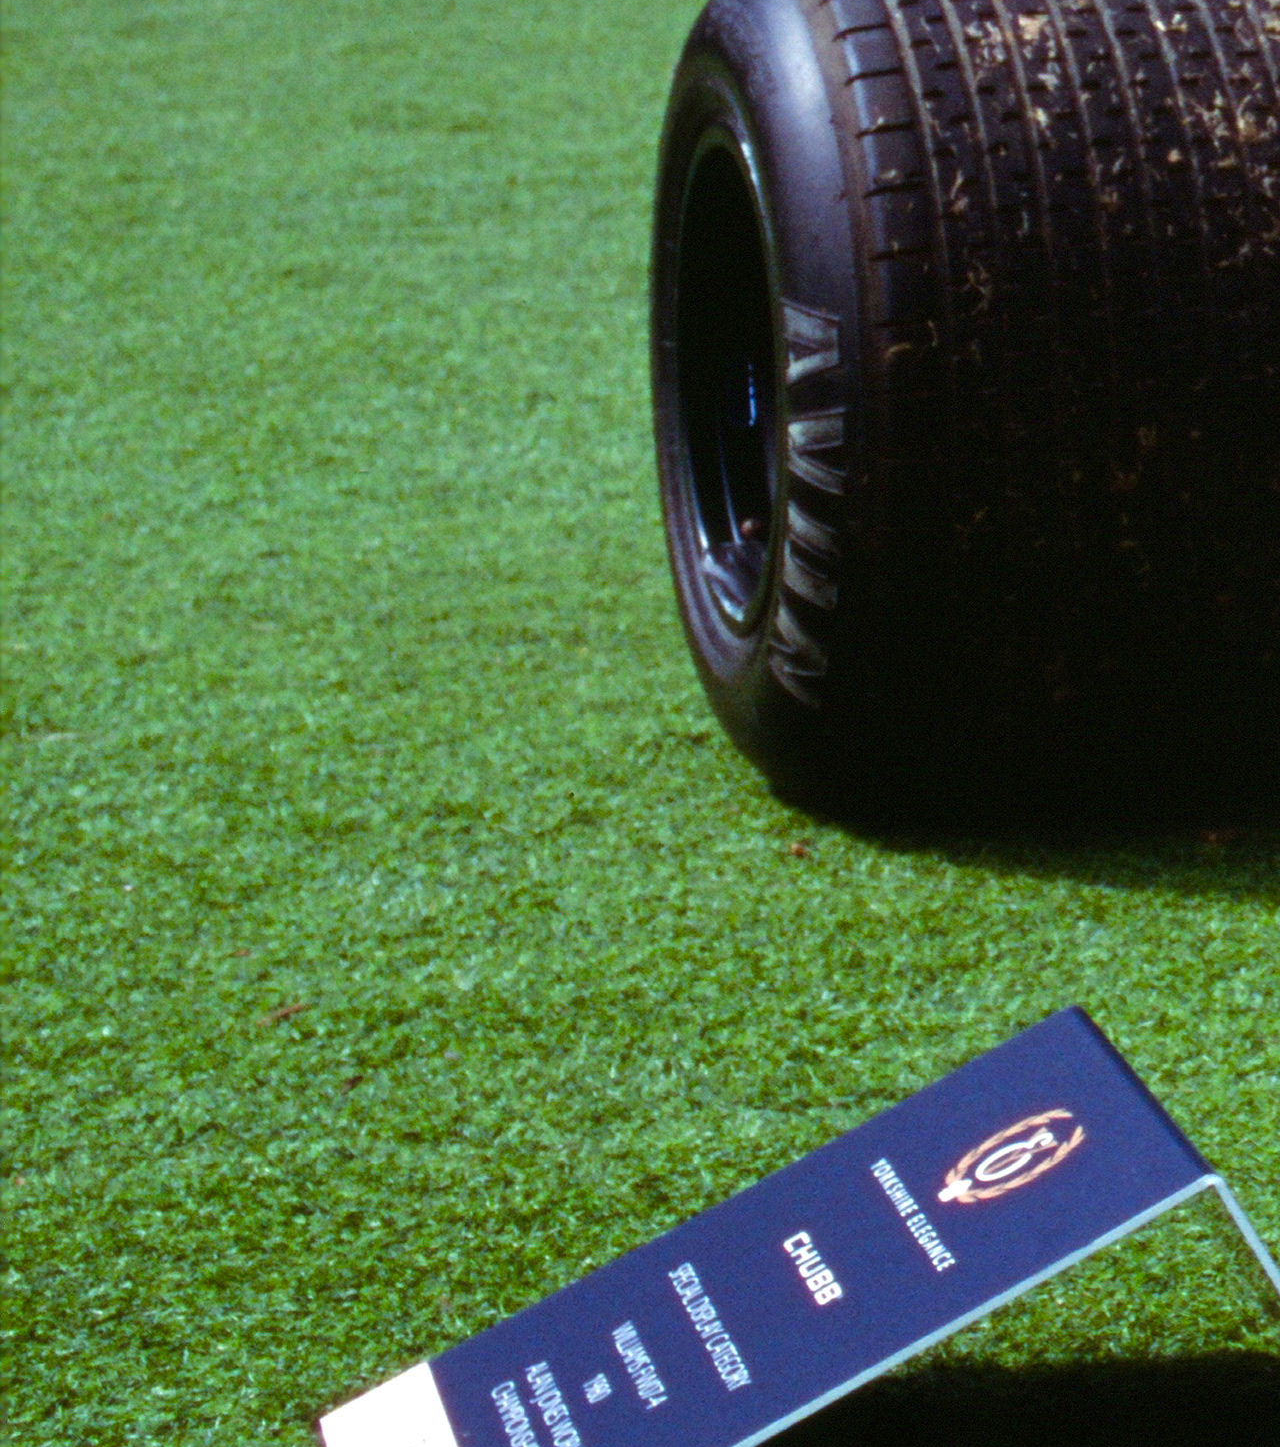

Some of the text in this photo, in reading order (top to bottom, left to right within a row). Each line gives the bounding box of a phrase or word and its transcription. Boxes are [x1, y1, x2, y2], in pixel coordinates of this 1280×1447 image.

[870, 1158, 954, 1271] YORKSHIRE ELEGANCE
[783, 1230, 842, 1306] CHUBB
[610, 1321, 649, 1372] WILLIAMS
[668, 1262, 751, 1392] SPECIAL DISPLAY CATEGORY
[525, 1359, 554, 1394] ALAN
[531, 1386, 567, 1428] JONES
